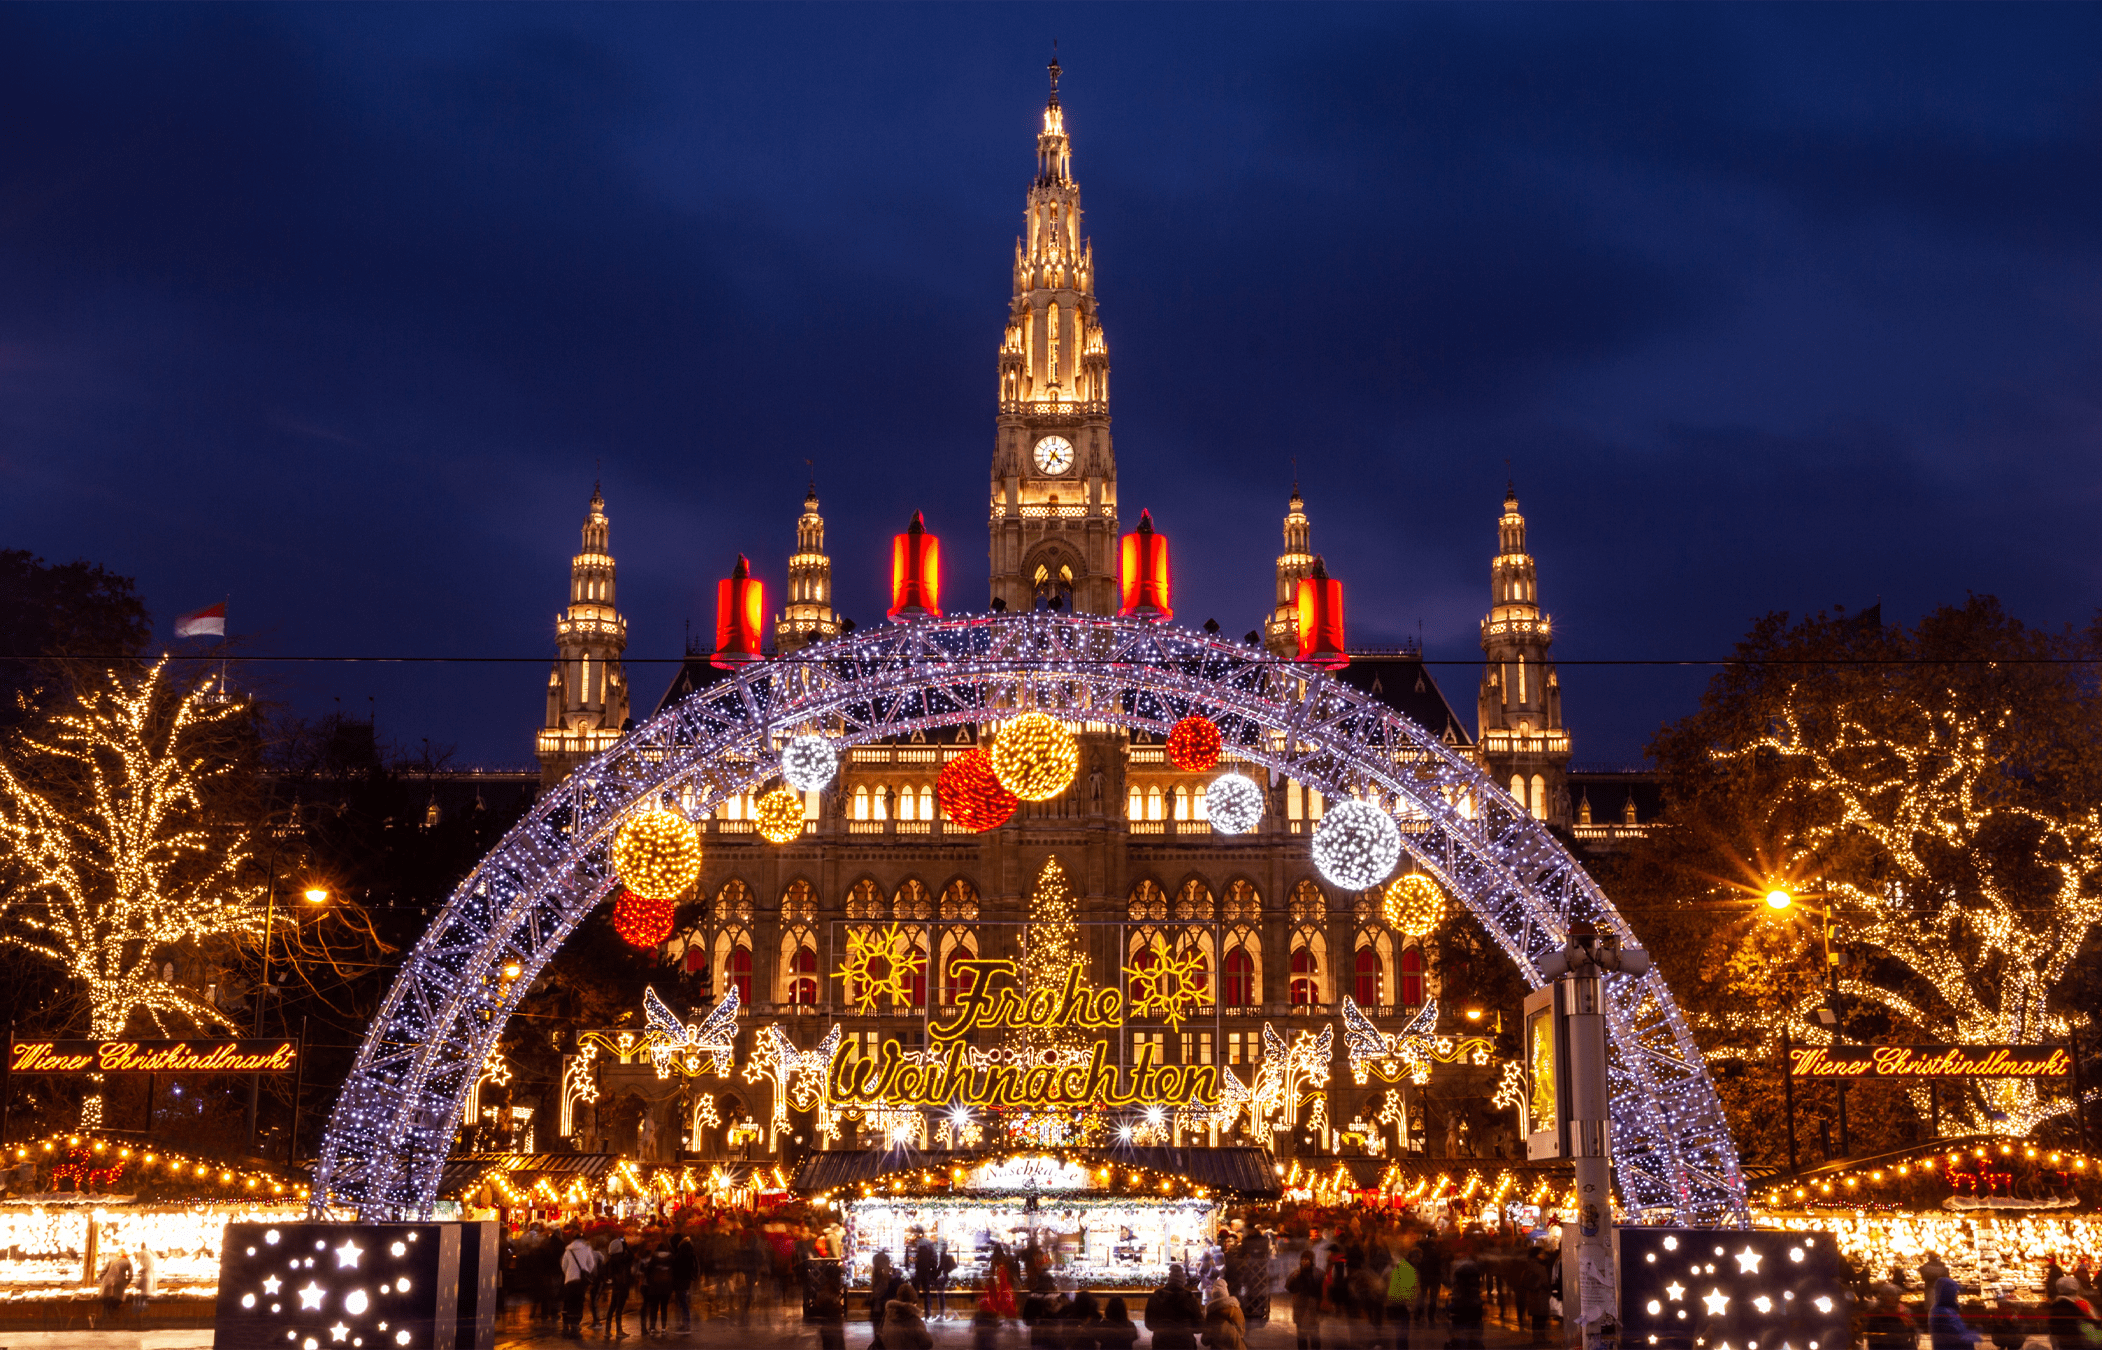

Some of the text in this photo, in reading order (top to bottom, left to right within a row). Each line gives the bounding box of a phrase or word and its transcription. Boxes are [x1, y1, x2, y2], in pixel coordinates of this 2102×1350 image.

[928, 959, 1123, 1041] Frohe
[12, 1042, 296, 1070] Wiener Christkindlmarkt
[1790, 1047, 2071, 1075] Wiener Christkindlmarkt
[827, 1039, 1220, 1106] Weihnachten
[985, 1160, 1078, 1181] Naschkae
